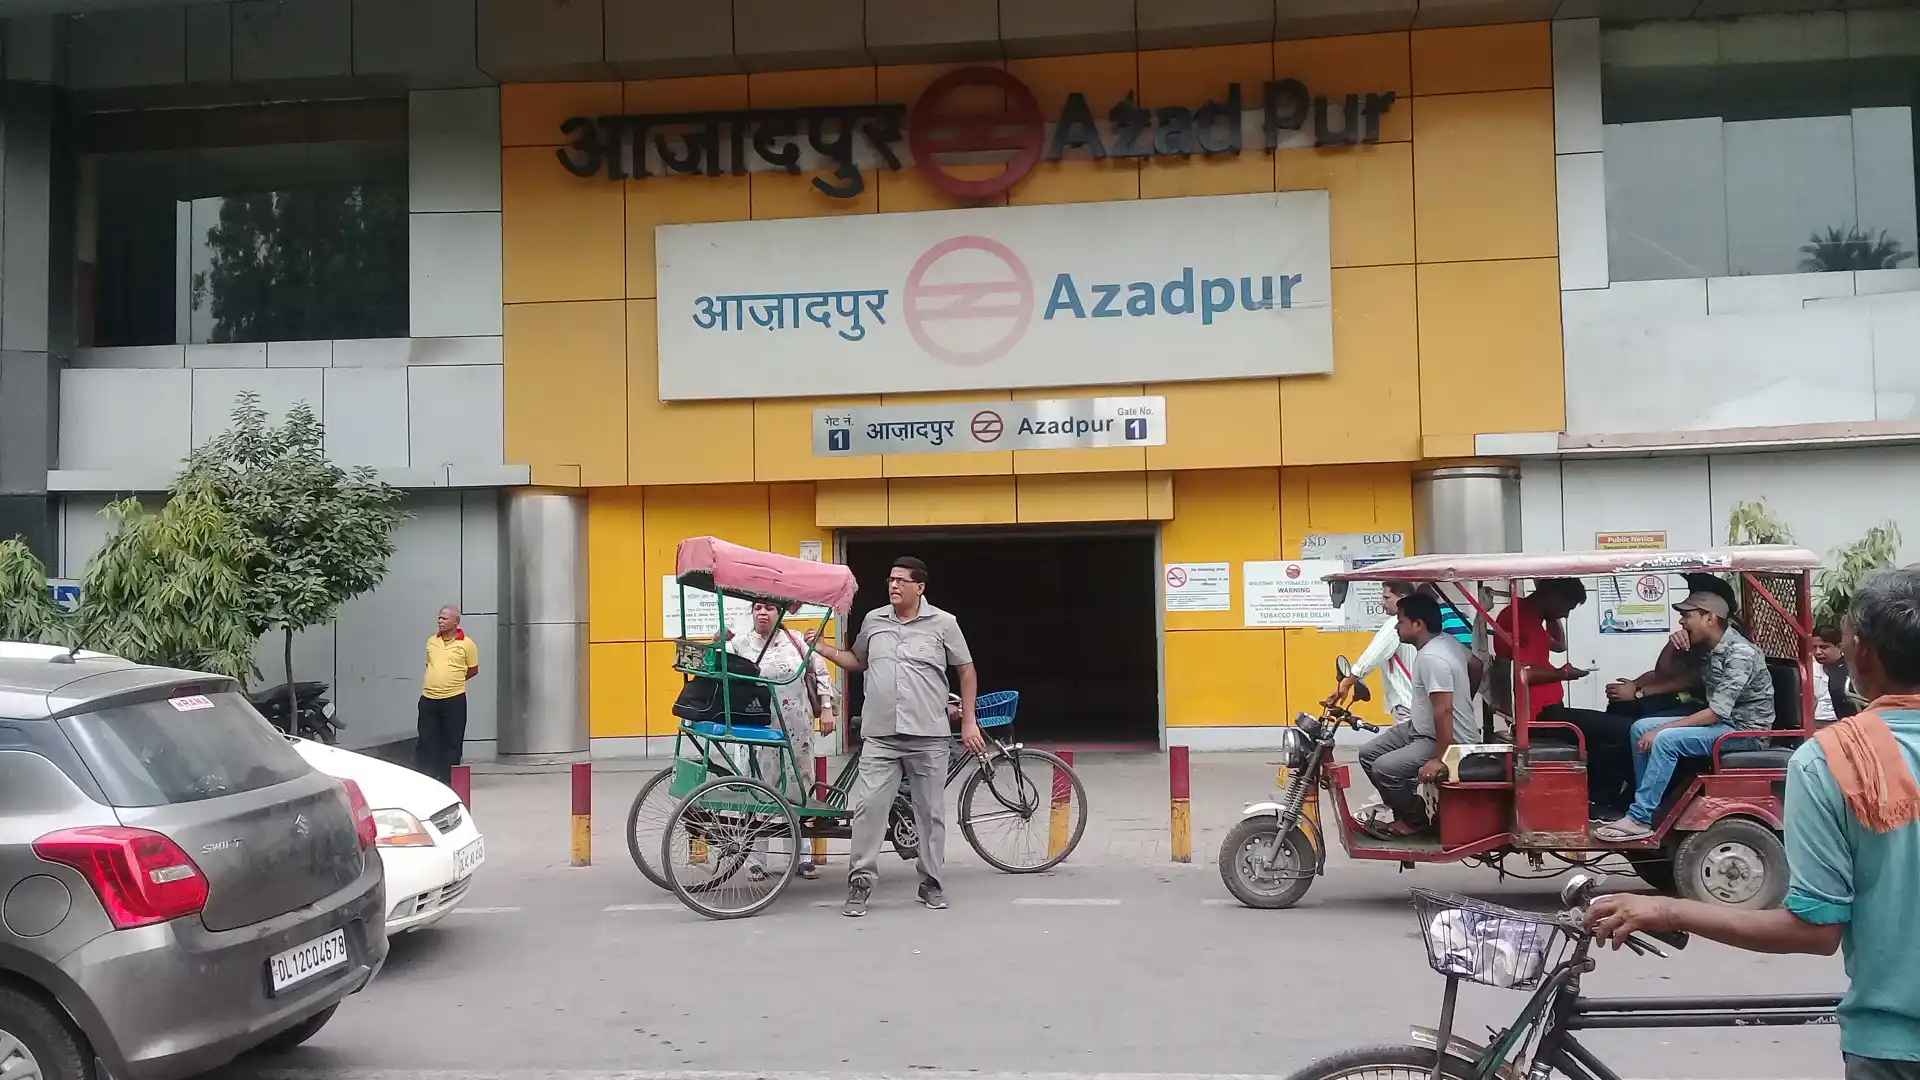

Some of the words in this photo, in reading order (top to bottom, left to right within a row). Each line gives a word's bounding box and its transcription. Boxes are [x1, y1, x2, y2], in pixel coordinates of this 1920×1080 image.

[1043, 267, 1302, 325] Azadpur
[692, 289, 889, 341] आज़ादपुर
[824, 415, 840, 427] गेट
[1117, 407, 1137, 416] Gate
[1139, 406, 1154, 415] No.
[867, 420, 955, 446] आज़ादपुर
[1018, 416, 1114, 438] Azadpur
[1130, 417, 1140, 440] 1
[834, 431, 844, 449] 1
[1363, 533, 1402, 545] BOND
